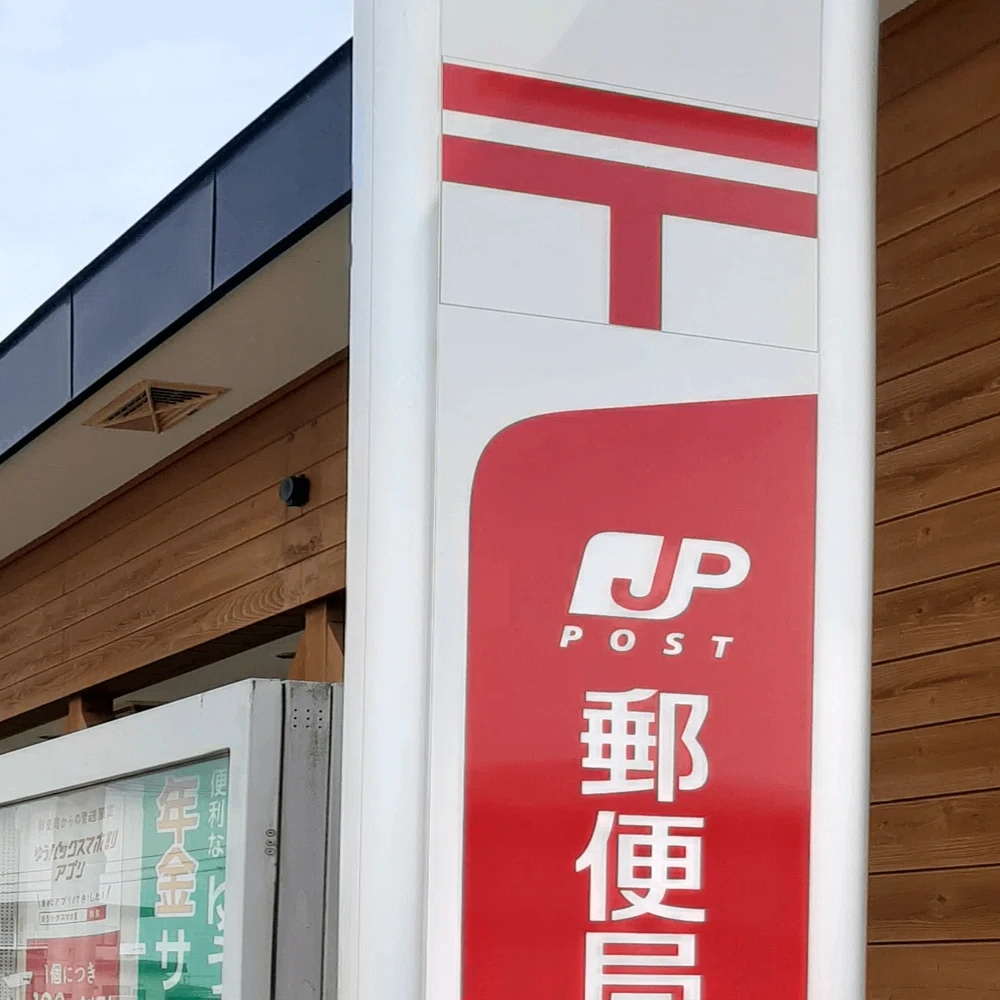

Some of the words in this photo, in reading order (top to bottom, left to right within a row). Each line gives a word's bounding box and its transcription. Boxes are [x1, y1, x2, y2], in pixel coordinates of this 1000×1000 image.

[559, 625, 734, 659] POST
[54, 859, 86, 881] アプリ
[44, 962, 96, 985] 1個につき
